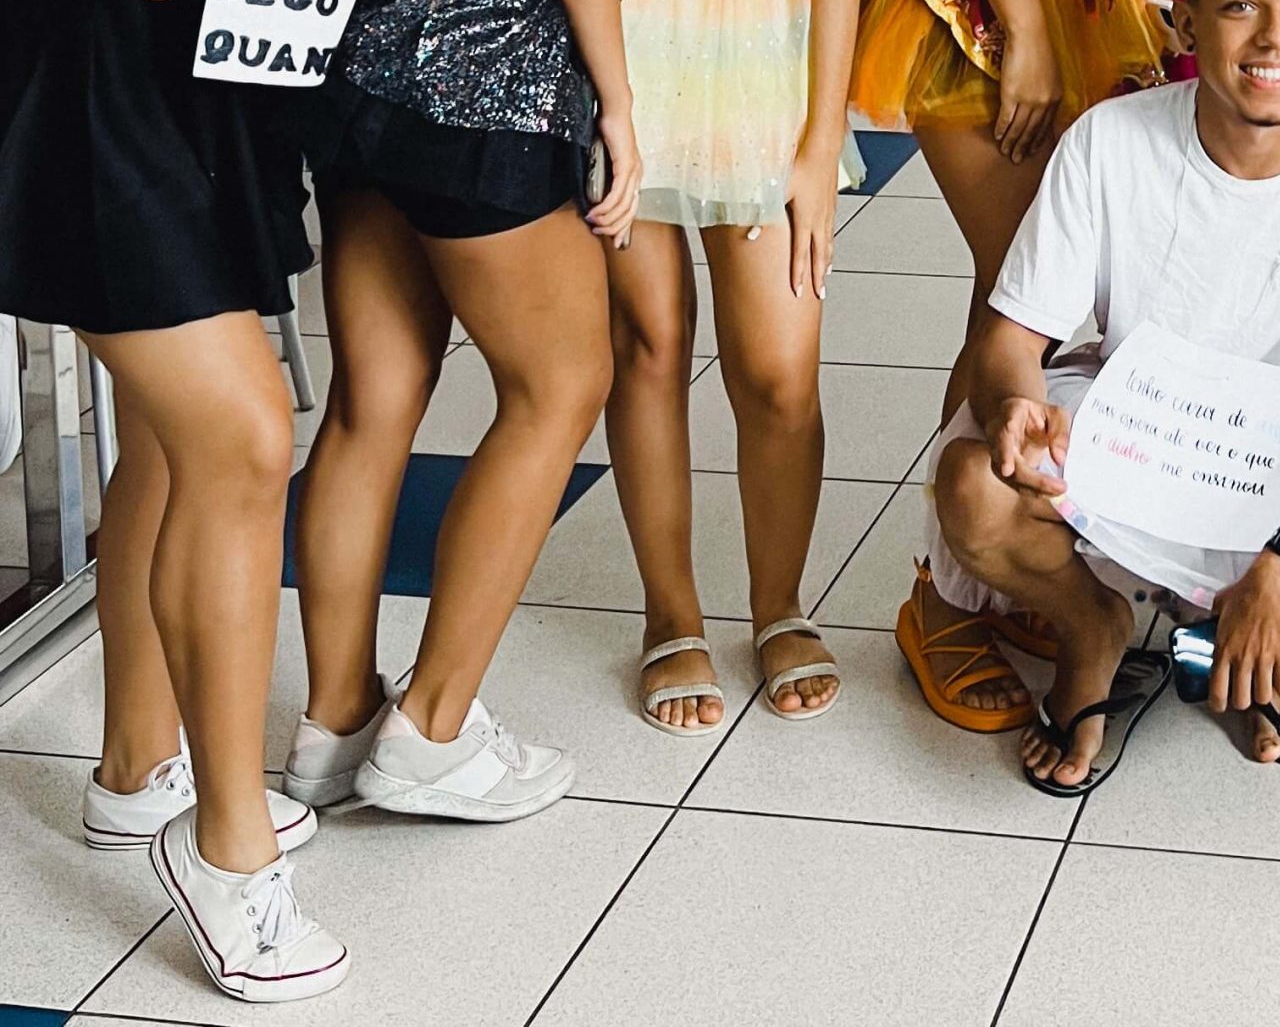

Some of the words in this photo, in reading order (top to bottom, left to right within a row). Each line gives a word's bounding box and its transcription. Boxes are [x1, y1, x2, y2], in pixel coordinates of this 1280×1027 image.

[200, 29, 335, 76] QUAN
[1228, 408, 1248, 429] de
[1160, 460, 1183, 478] me
[1244, 451, 1276, 474] que
